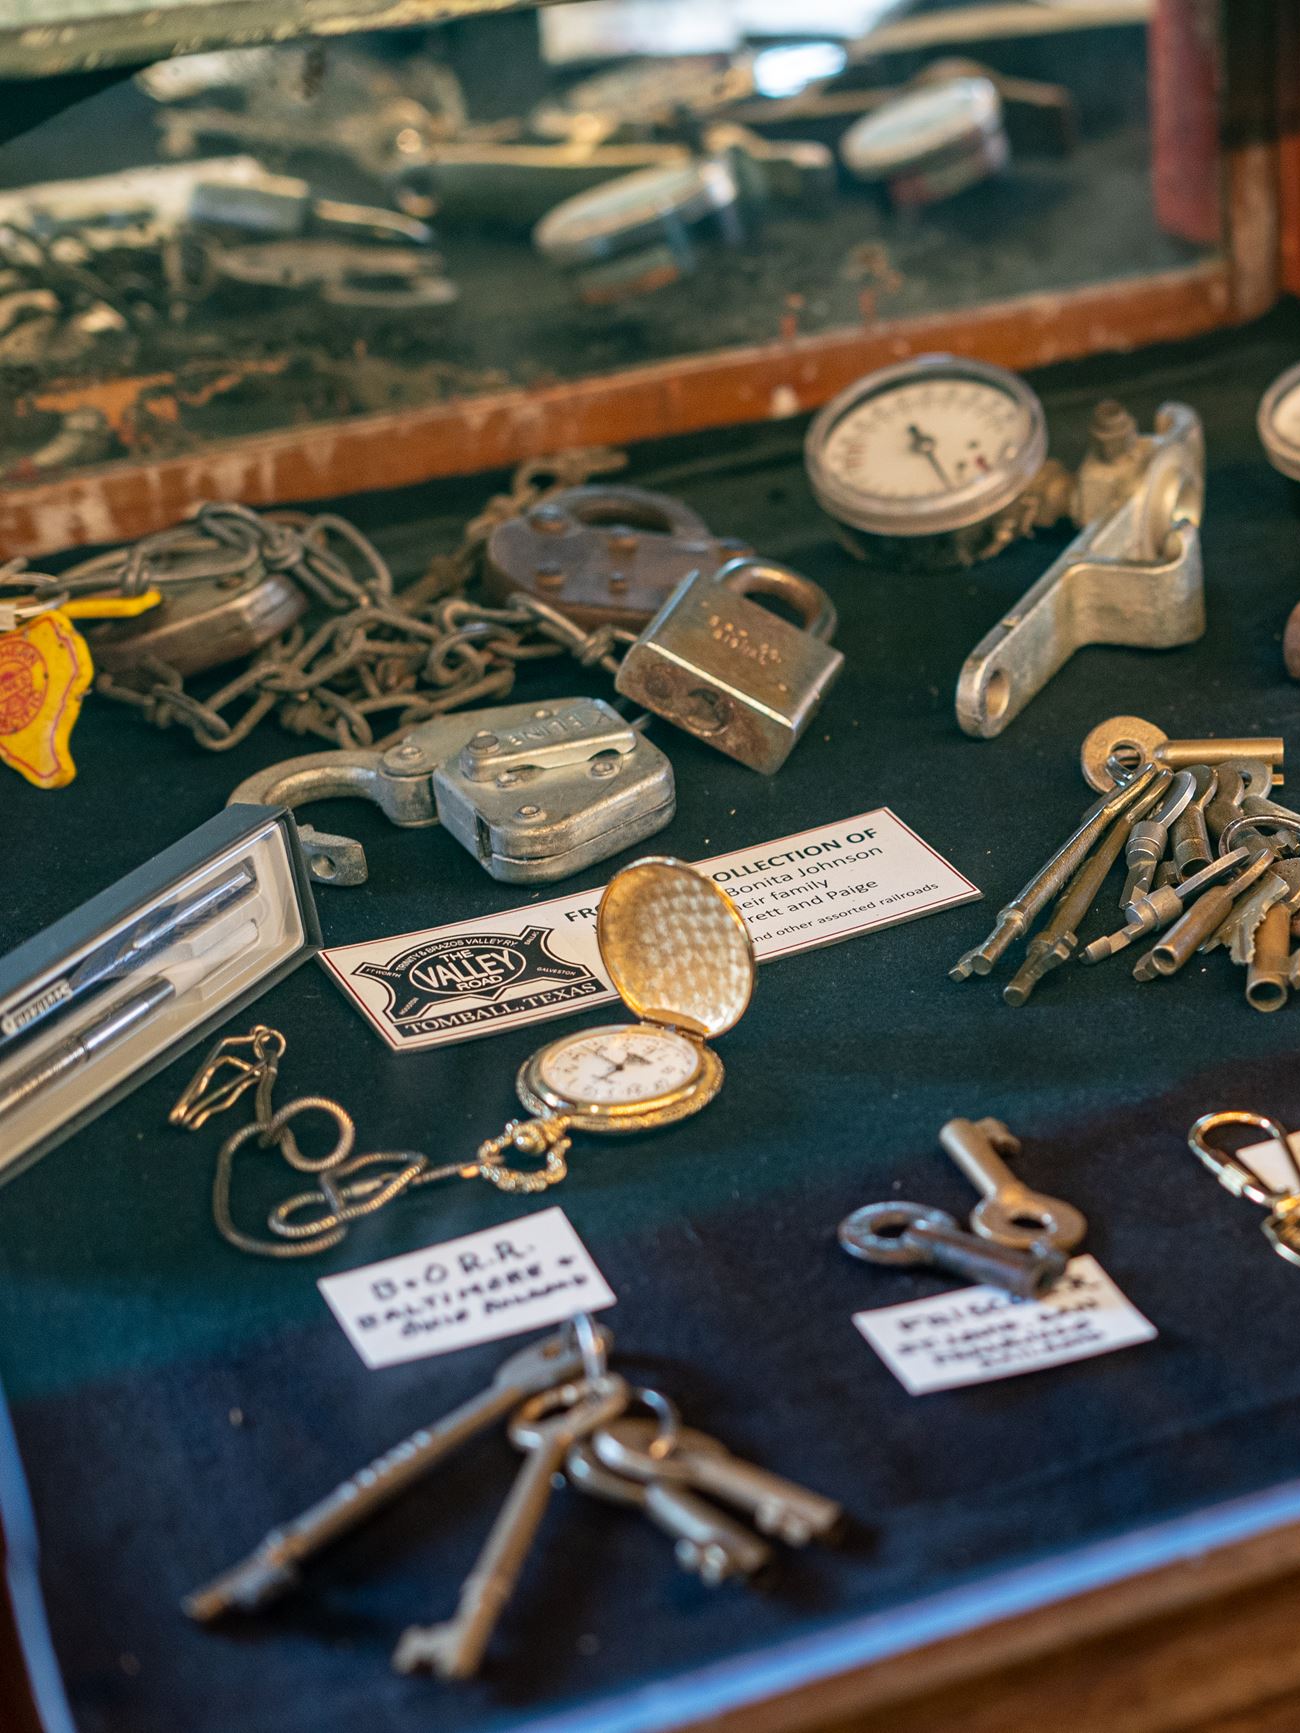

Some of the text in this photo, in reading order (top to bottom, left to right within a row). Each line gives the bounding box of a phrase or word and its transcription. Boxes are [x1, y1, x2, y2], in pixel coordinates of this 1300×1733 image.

[564, 828, 878, 922] FR OLLECTION OF
[724, 846, 883, 898] Bonita Johnson
[769, 879, 829, 901] family
[776, 919, 813, 936] other
[817, 901, 877, 924] assorted
[879, 881, 939, 905] railroads
[788, 894, 824, 913] and
[828, 880, 879, 904] Paige
[426, 939, 464, 955] BRAZOS
[465, 937, 501, 946] VALLEY
[438, 949, 475, 963] THE
[414, 949, 516, 989] VALLEY
[456, 975, 503, 992] ROAD
[404, 981, 598, 1036] TOMBALL, TEXAS
